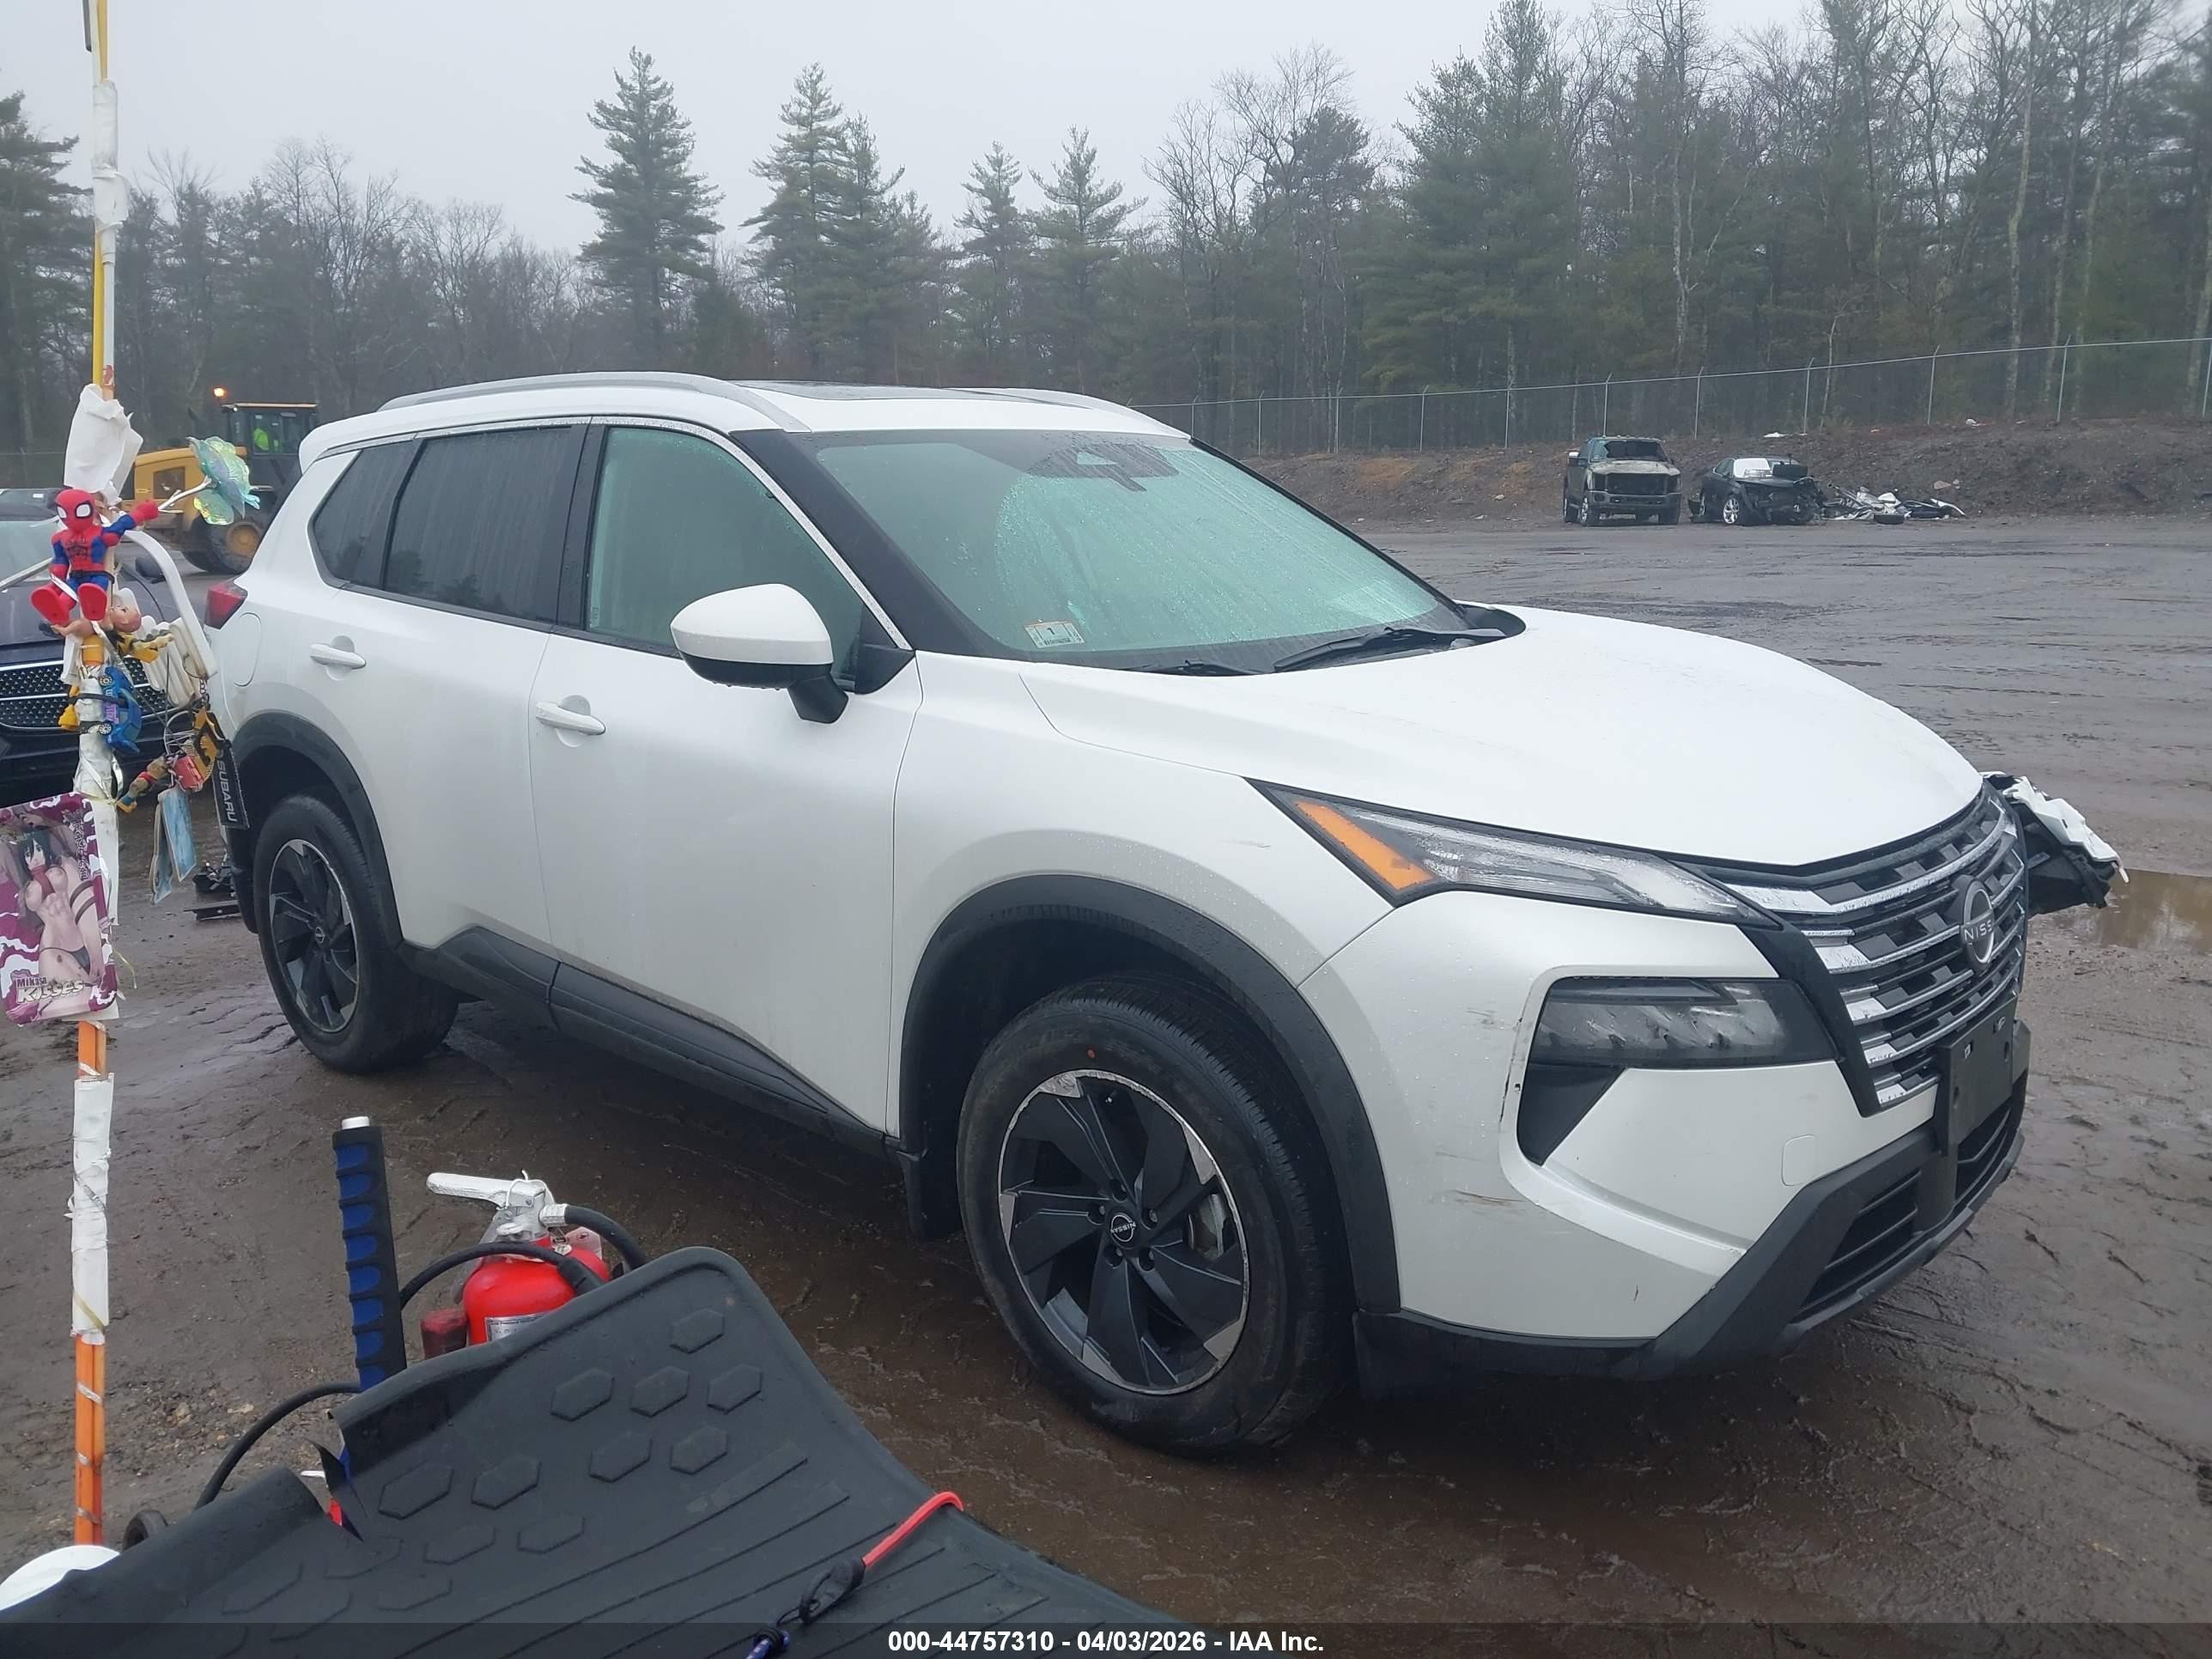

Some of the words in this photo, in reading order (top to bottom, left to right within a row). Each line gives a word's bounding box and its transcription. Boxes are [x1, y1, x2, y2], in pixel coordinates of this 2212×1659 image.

[216, 760, 238, 823] SUBARU
[1964, 919, 1993, 941] NISS
[17, 977, 47, 988] Mikasa
[17, 980, 84, 1004] Kisses
